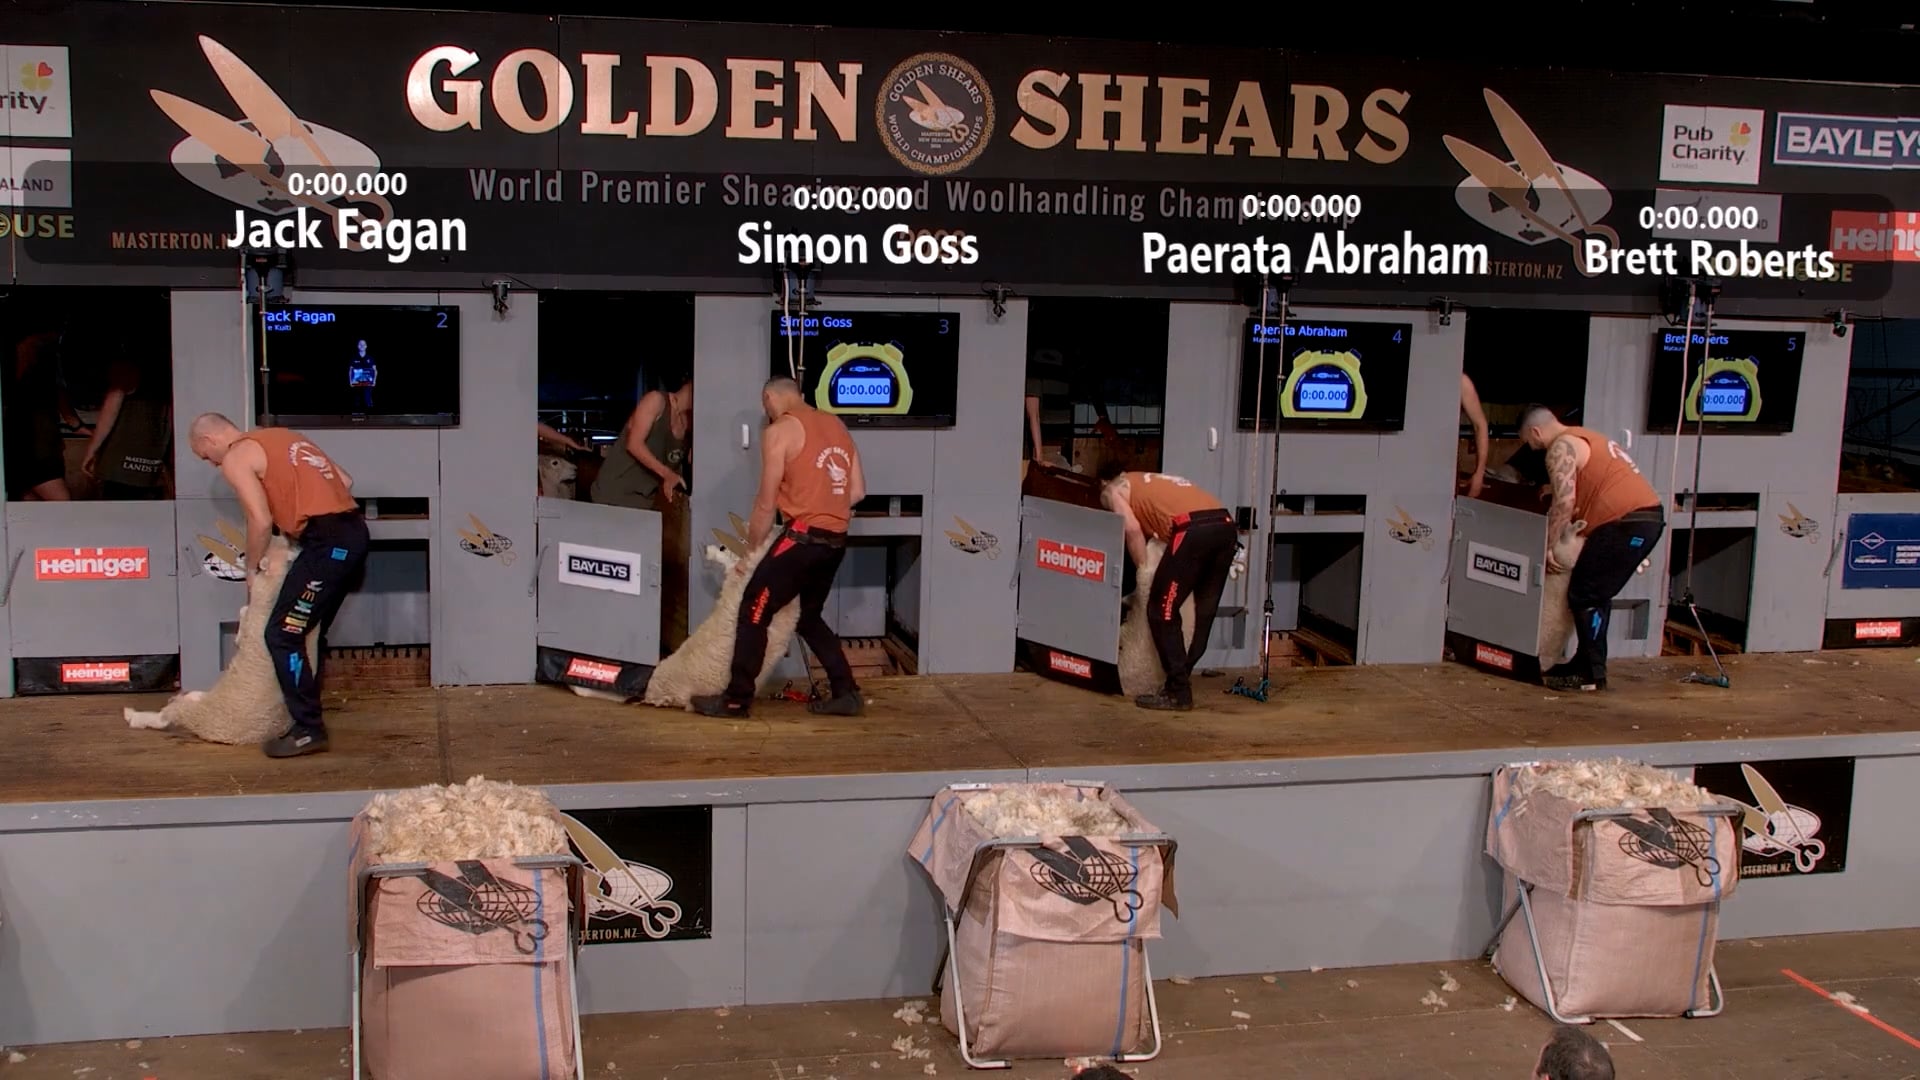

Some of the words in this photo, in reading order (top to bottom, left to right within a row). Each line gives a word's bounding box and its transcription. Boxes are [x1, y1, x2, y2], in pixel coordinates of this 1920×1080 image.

[889, 64, 934, 102] GOLDEN
[938, 64, 983, 104] SHEARS
[406, 46, 863, 142] GOLDEN
[1010, 69, 1411, 164] SHEARS
[888, 114, 911, 152] WORLD
[910, 115, 984, 164] CHAMPIONSHIPS
[1674, 125, 1713, 142] Pub
[1787, 125, 1920, 158] BAYLEY
[1672, 143, 1746, 165] Charity
[469, 169, 563, 202] World
[581, 170, 707, 205] Premier
[945, 179, 1145, 222] Woolhandling
[111, 231, 236, 250] MASTERTON.N
[265, 310, 292, 322] ack
[294, 310, 336, 324] Fagan
[436, 312, 448, 328] 2
[780, 316, 819, 328] Simon
[822, 316, 853, 328] Goss
[938, 319, 950, 335] 3
[1297, 325, 1348, 337] Abraham
[1392, 329, 1403, 344] 4
[1664, 333, 1686, 344] Bret
[1691, 333, 1729, 345] Roerts
[1787, 337, 1797, 351] 5
[838, 384, 891, 396] 0:00.000
[1301, 389, 1348, 401] 0:00.000
[1704, 394, 1744, 405] 0:00.000
[40, 547, 147, 577] Heiniger
[1040, 542, 1103, 576] Heiniger
[1475, 556, 1519, 578] BAYLEYS
[570, 558, 629, 579] BAYLEYS
[65, 663, 129, 680] Heiniger
[571, 661, 620, 681] Heiniger
[1050, 654, 1091, 674] Heiniger
